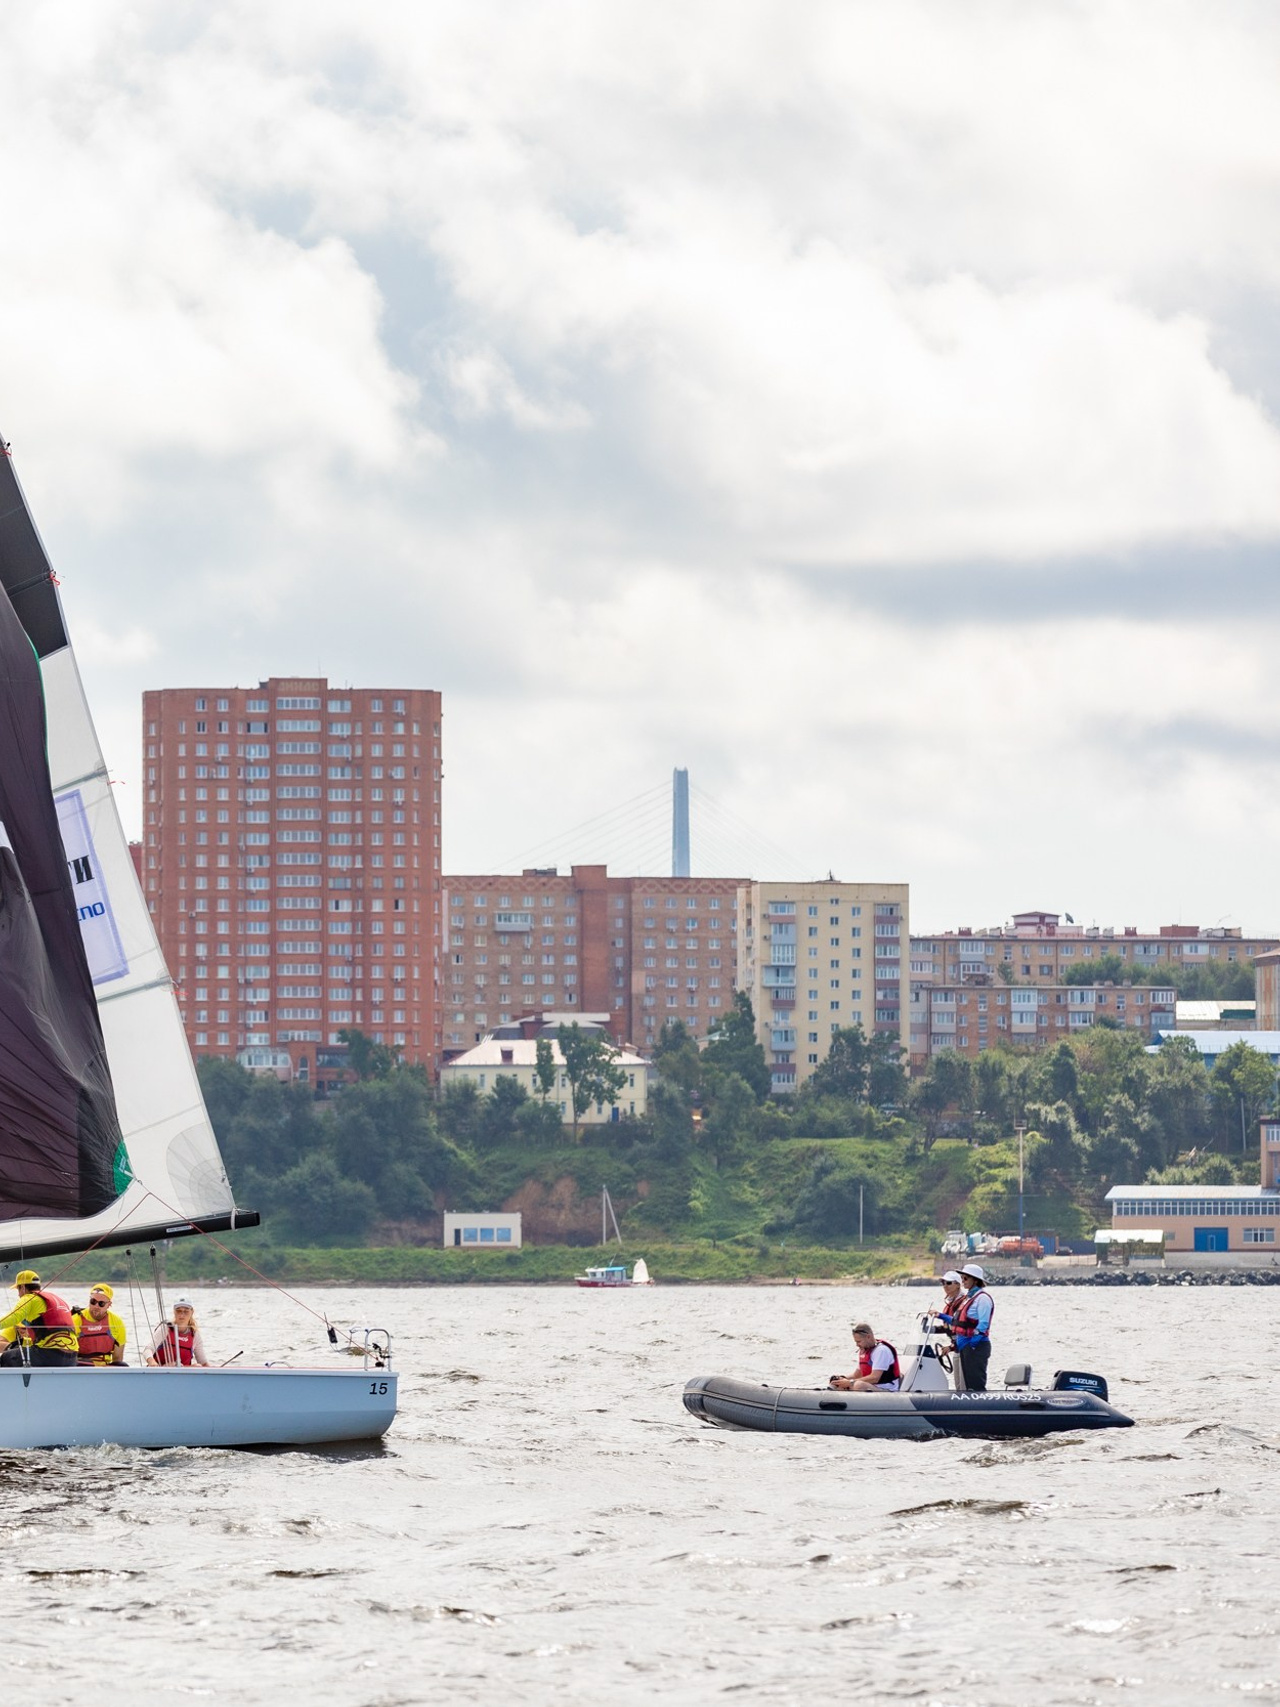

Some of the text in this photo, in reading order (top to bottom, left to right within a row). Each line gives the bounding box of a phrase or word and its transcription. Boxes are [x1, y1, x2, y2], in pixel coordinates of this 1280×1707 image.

[67, 854, 94, 884] И
[1069, 1377, 1098, 1386] SUZUKI
[369, 1382, 388, 1395] 15
